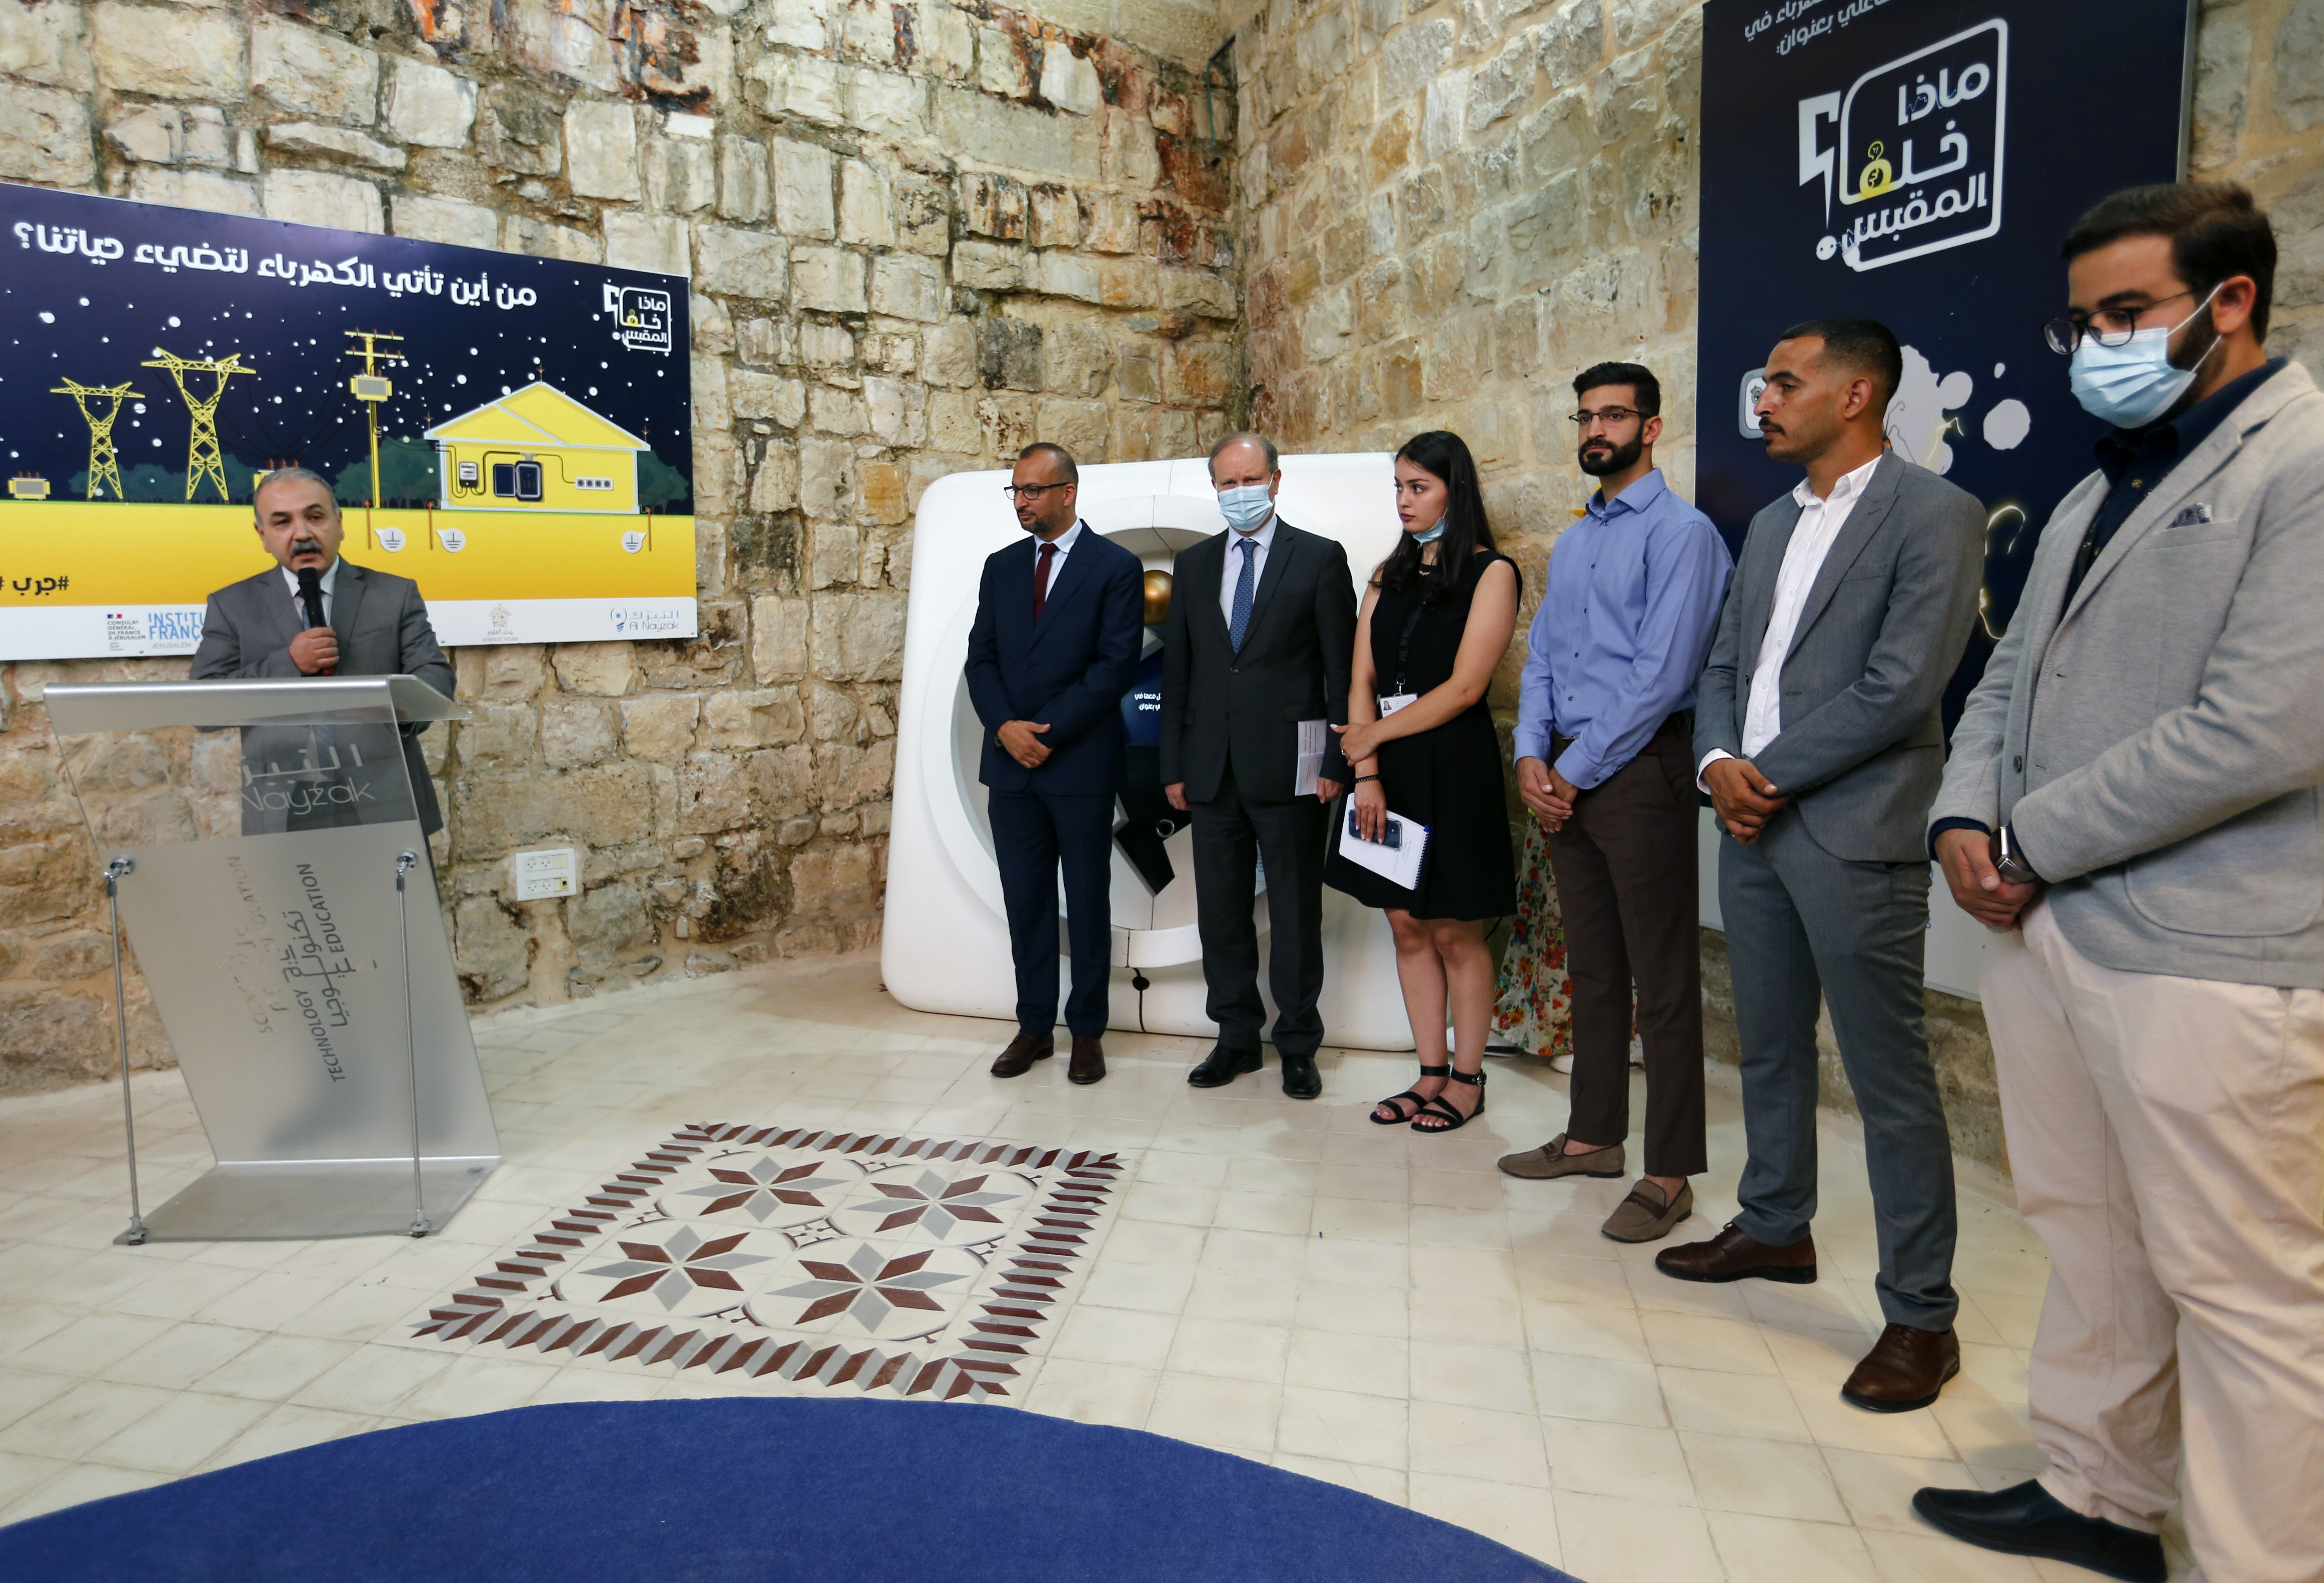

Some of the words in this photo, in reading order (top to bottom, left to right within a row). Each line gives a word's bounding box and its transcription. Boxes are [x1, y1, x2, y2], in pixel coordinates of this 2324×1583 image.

[1744, 10, 1772, 42] في
[1776, 15, 1834, 56] بعنوان:
[1898, 63, 1990, 127] ماذا
[1859, 119, 1968, 199] خلف
[1841, 172, 1987, 253] المقبس
[13, 222, 125, 266] حياتنا؟
[134, 242, 250, 274] لتضيء
[257, 253, 377, 288] الكهرباء
[382, 265, 445, 298] تأتي
[450, 272, 490, 307] أين
[496, 283, 537, 310] من
[638, 296, 667, 312] ماذا
[626, 309, 661, 330] خلف
[622, 330, 668, 344] المقبس
[12, 576, 69, 596] #جرب
[148, 612, 204, 627] INSTITU
[629, 621, 638, 631] Al
[642, 620, 680, 632] Nayzak
[630, 610, 679, 622] النيزك
[149, 625, 200, 641] FRANÇ
[238, 743, 363, 787] النيز
[296, 863, 344, 954] EDUCATION
[293, 989, 346, 1083] TECHNOLOGY
